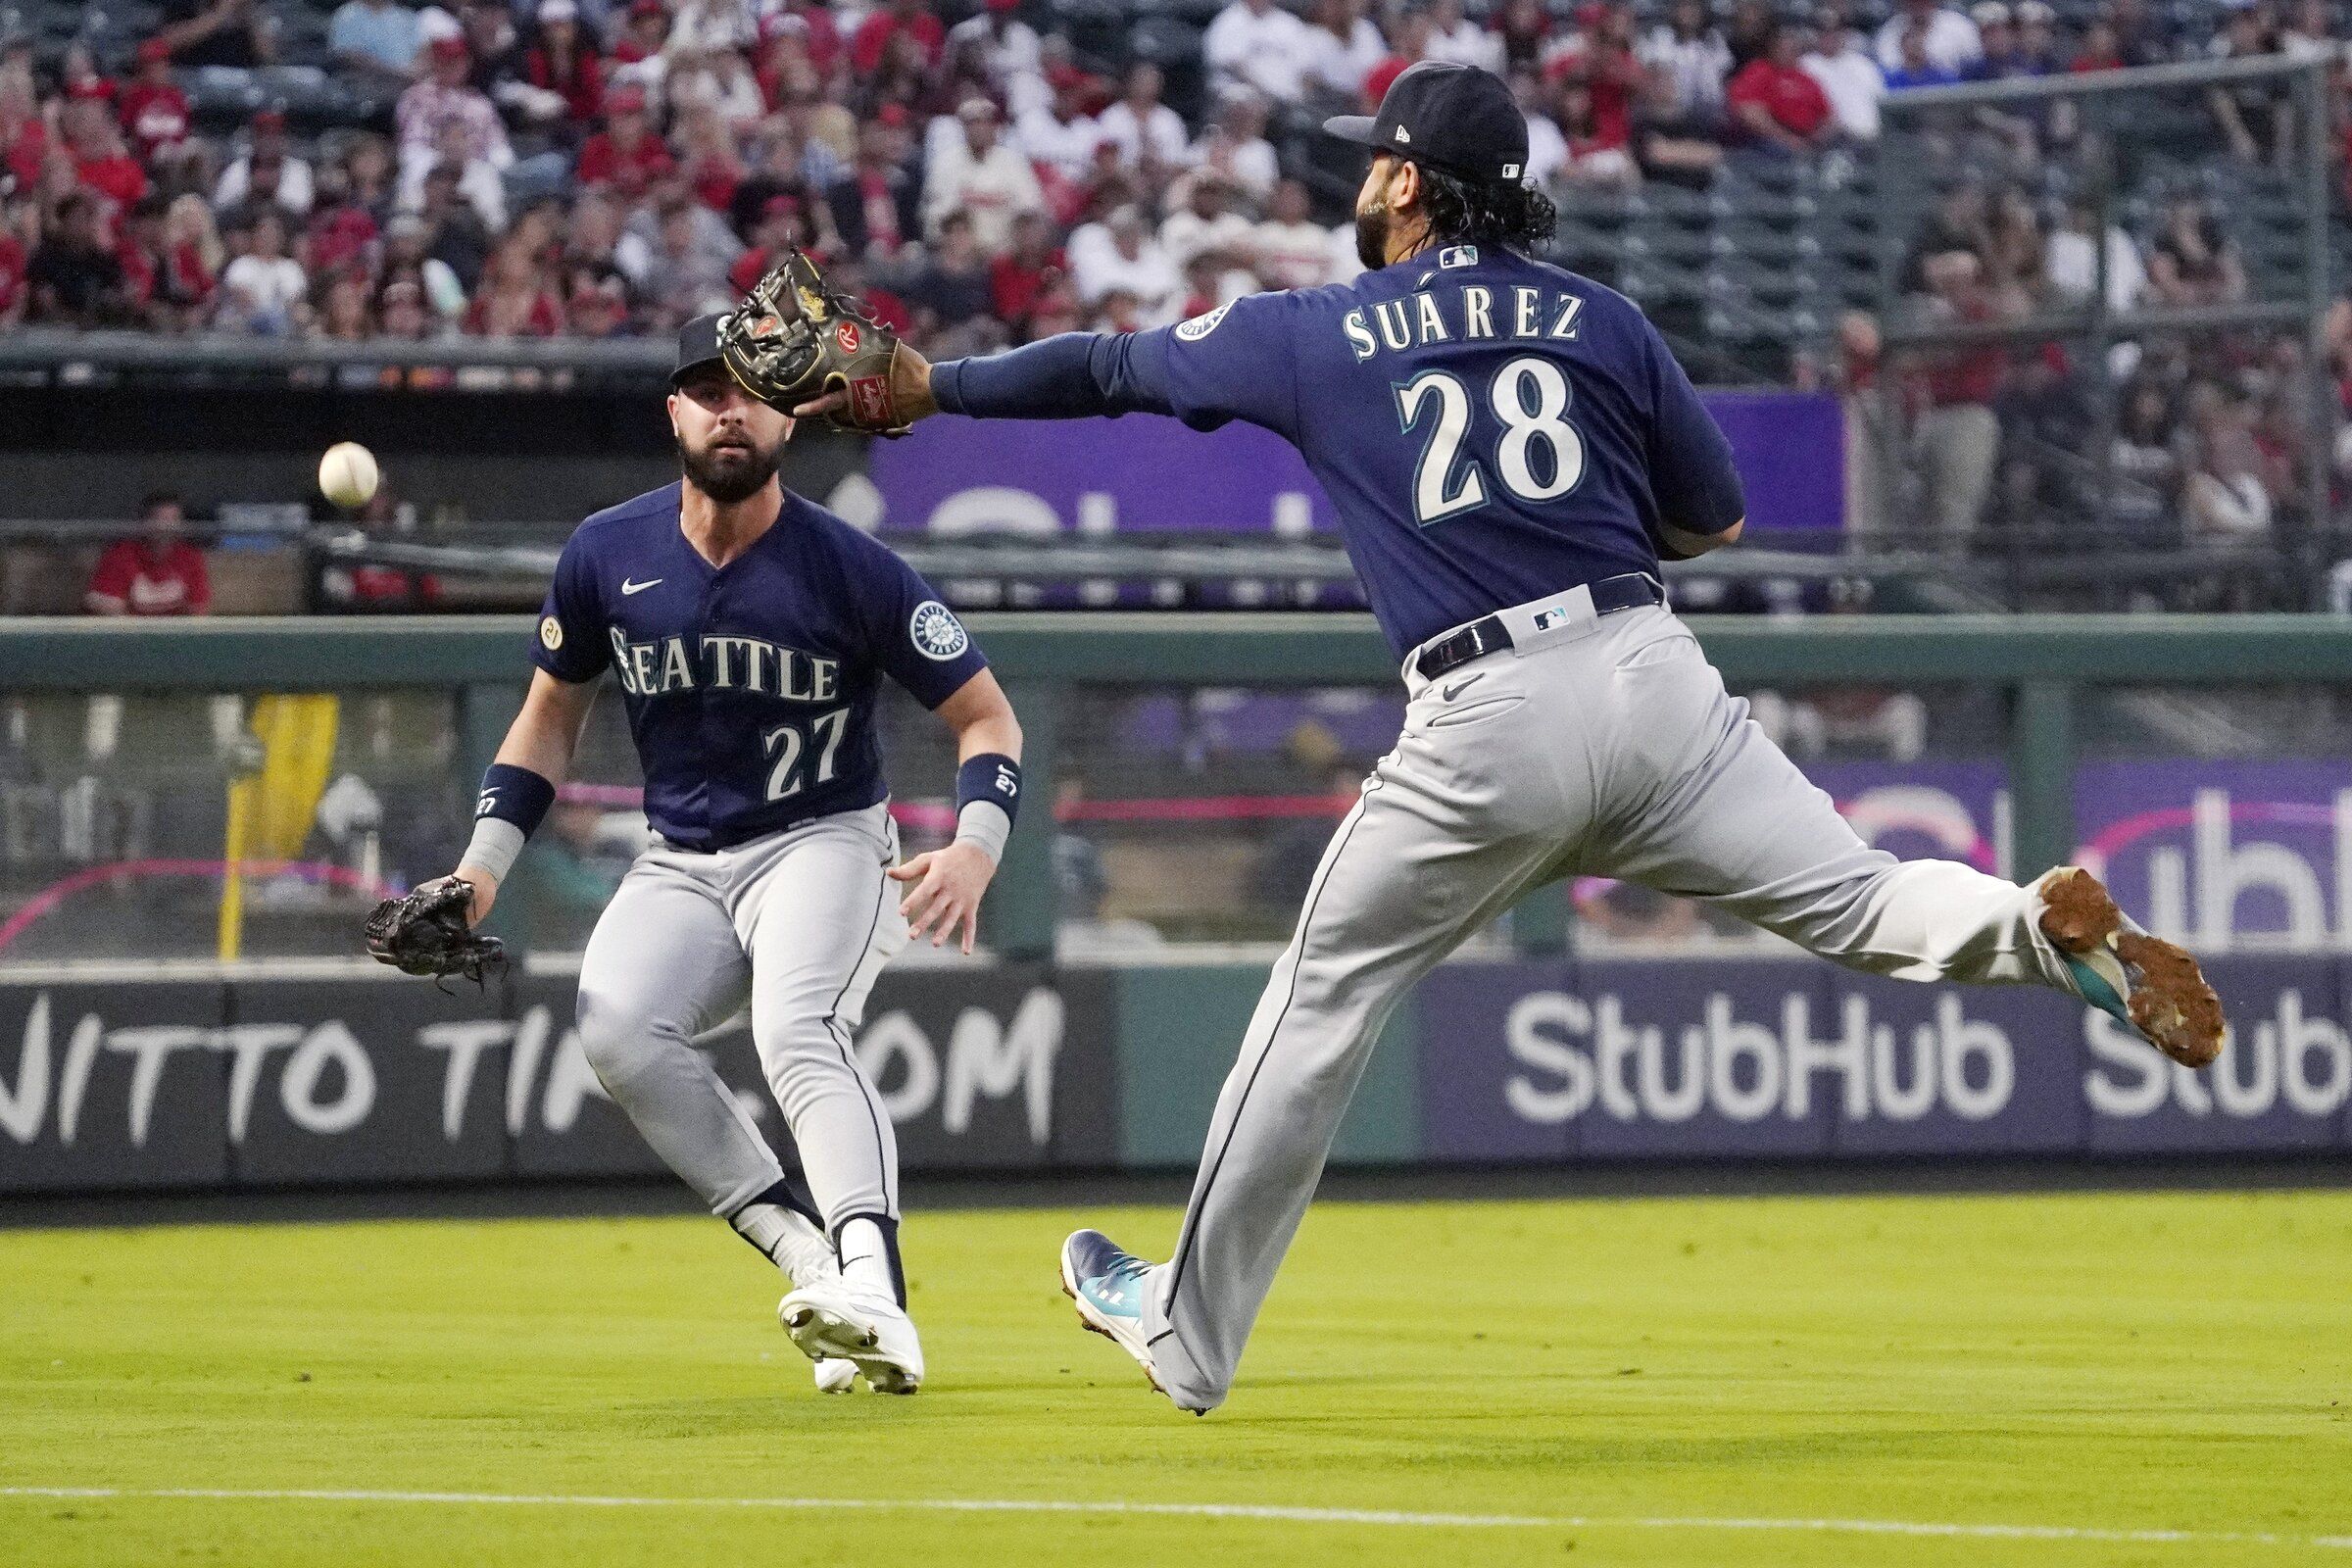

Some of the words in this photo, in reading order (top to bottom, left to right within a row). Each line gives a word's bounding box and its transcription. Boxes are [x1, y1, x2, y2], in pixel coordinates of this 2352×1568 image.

[1343, 270, 1586, 365] SUÁREZ
[1391, 354, 1588, 527] 28
[609, 625, 840, 703] SEATTLE
[764, 707, 851, 802] 27
[995, 773, 1017, 798] 27
[1505, 990, 2016, 1120] StubHub
